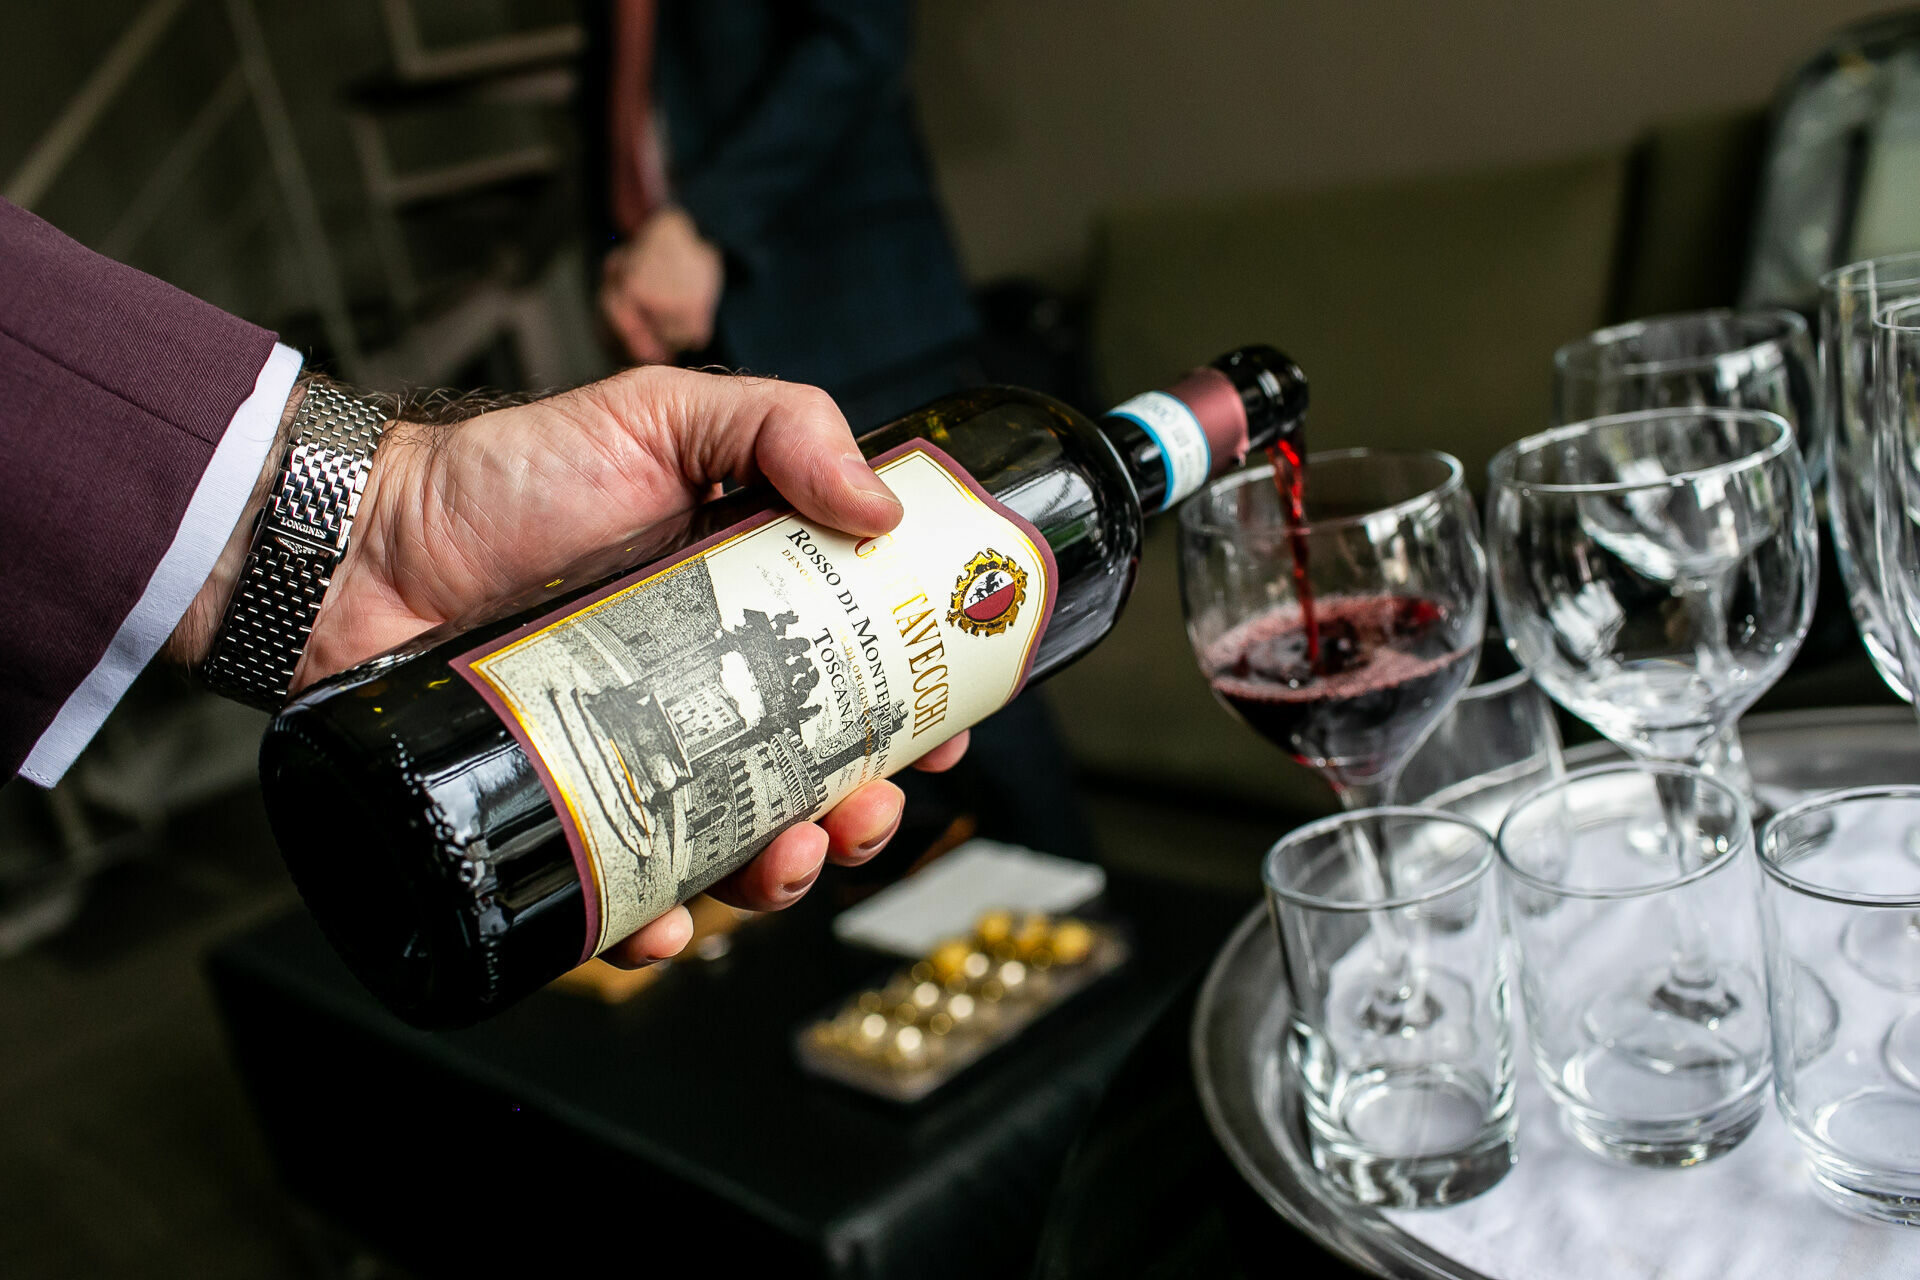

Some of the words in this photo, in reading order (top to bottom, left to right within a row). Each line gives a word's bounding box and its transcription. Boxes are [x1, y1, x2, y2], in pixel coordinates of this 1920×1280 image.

[280, 516, 327, 539] LONGINES
[785, 527, 841, 586] ROSSO
[836, 589, 859, 615] DI
[811, 627, 855, 733] TOSCANA
